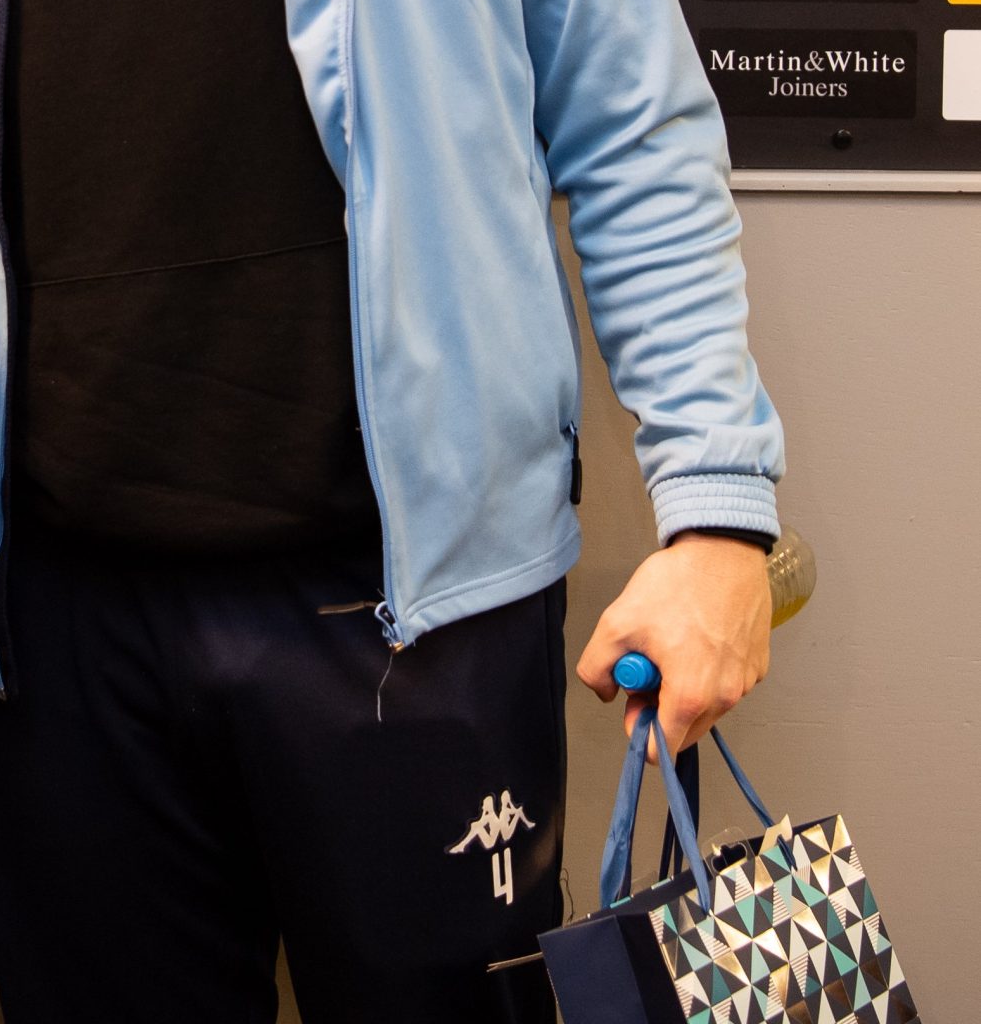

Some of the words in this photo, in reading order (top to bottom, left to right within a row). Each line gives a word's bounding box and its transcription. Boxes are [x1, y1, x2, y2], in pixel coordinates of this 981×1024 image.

[710, 49, 905, 72] Martin&White
[769, 76, 848, 98] Joiners
[492, 847, 513, 905] 4
